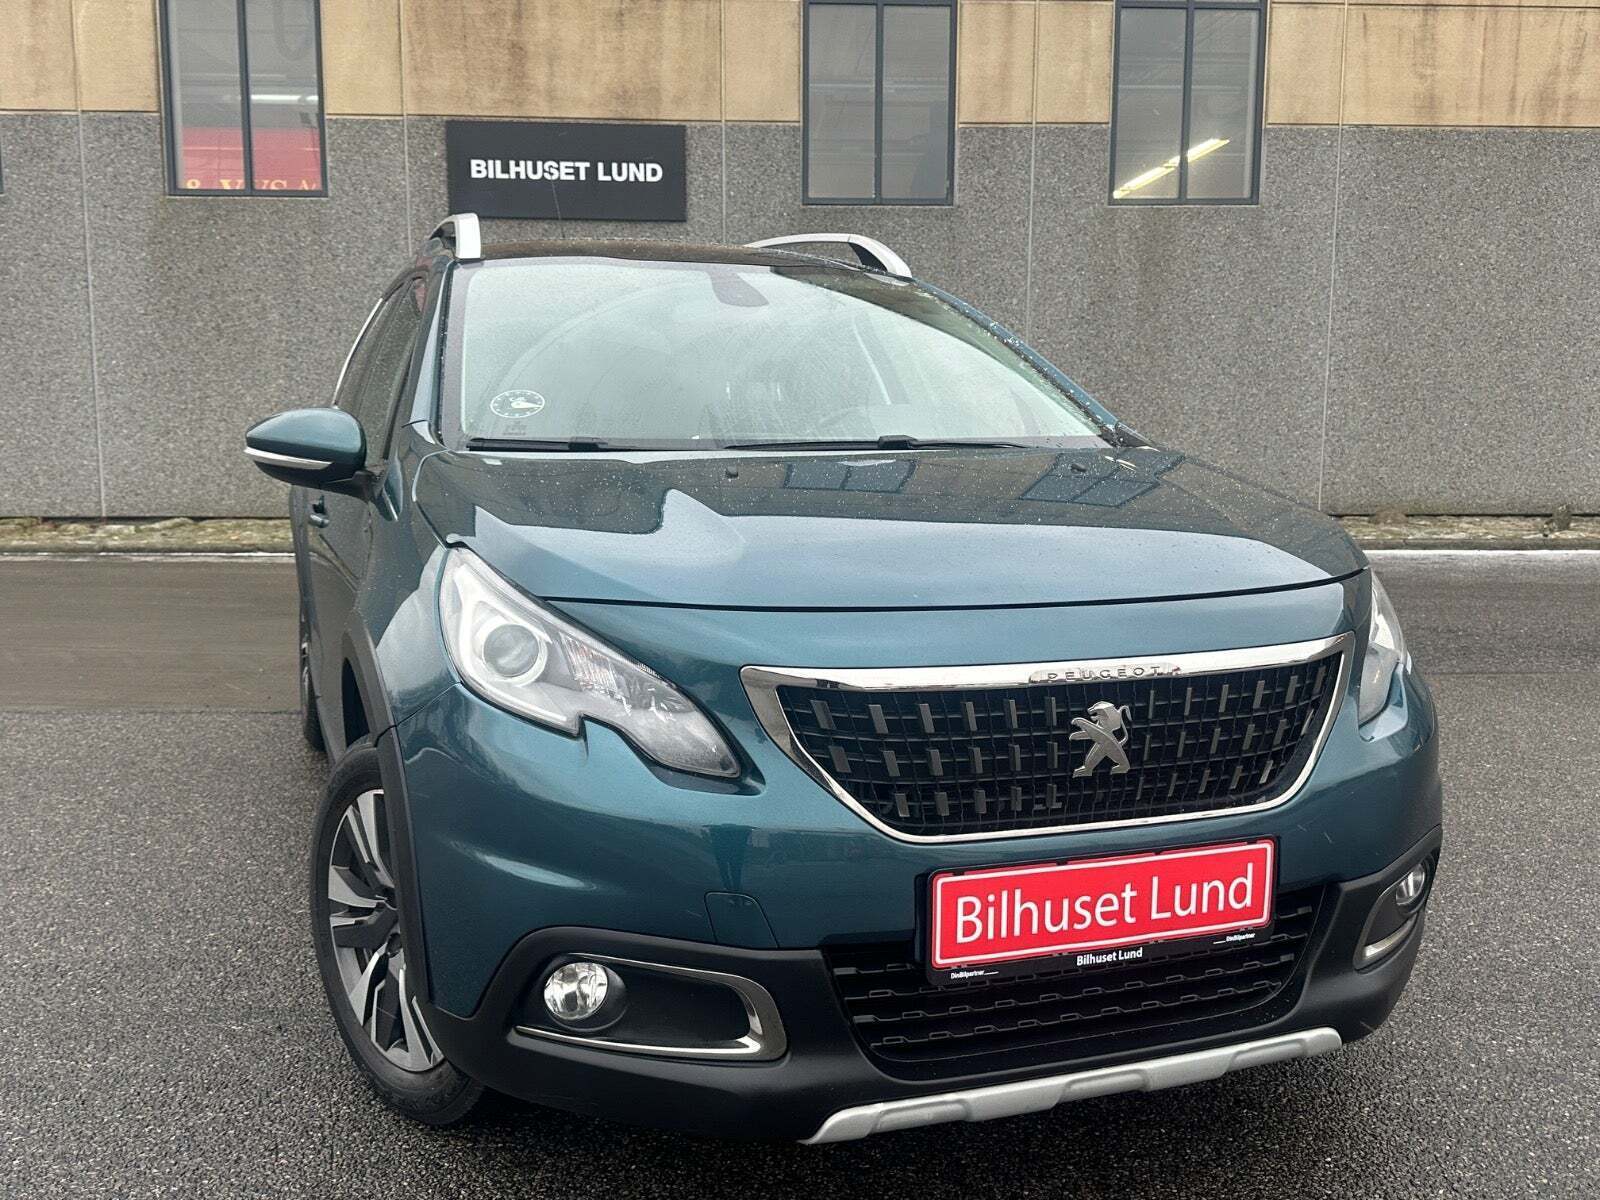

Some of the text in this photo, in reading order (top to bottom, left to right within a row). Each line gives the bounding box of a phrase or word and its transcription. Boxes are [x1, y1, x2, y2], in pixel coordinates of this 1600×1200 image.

[470, 159, 664, 182] BILHUSET LUND
[1047, 665, 1161, 682] PEUGEOT
[955, 862, 1255, 944] Bilhuset Lund
[1076, 946, 1144, 966] Bilhuset Lund
